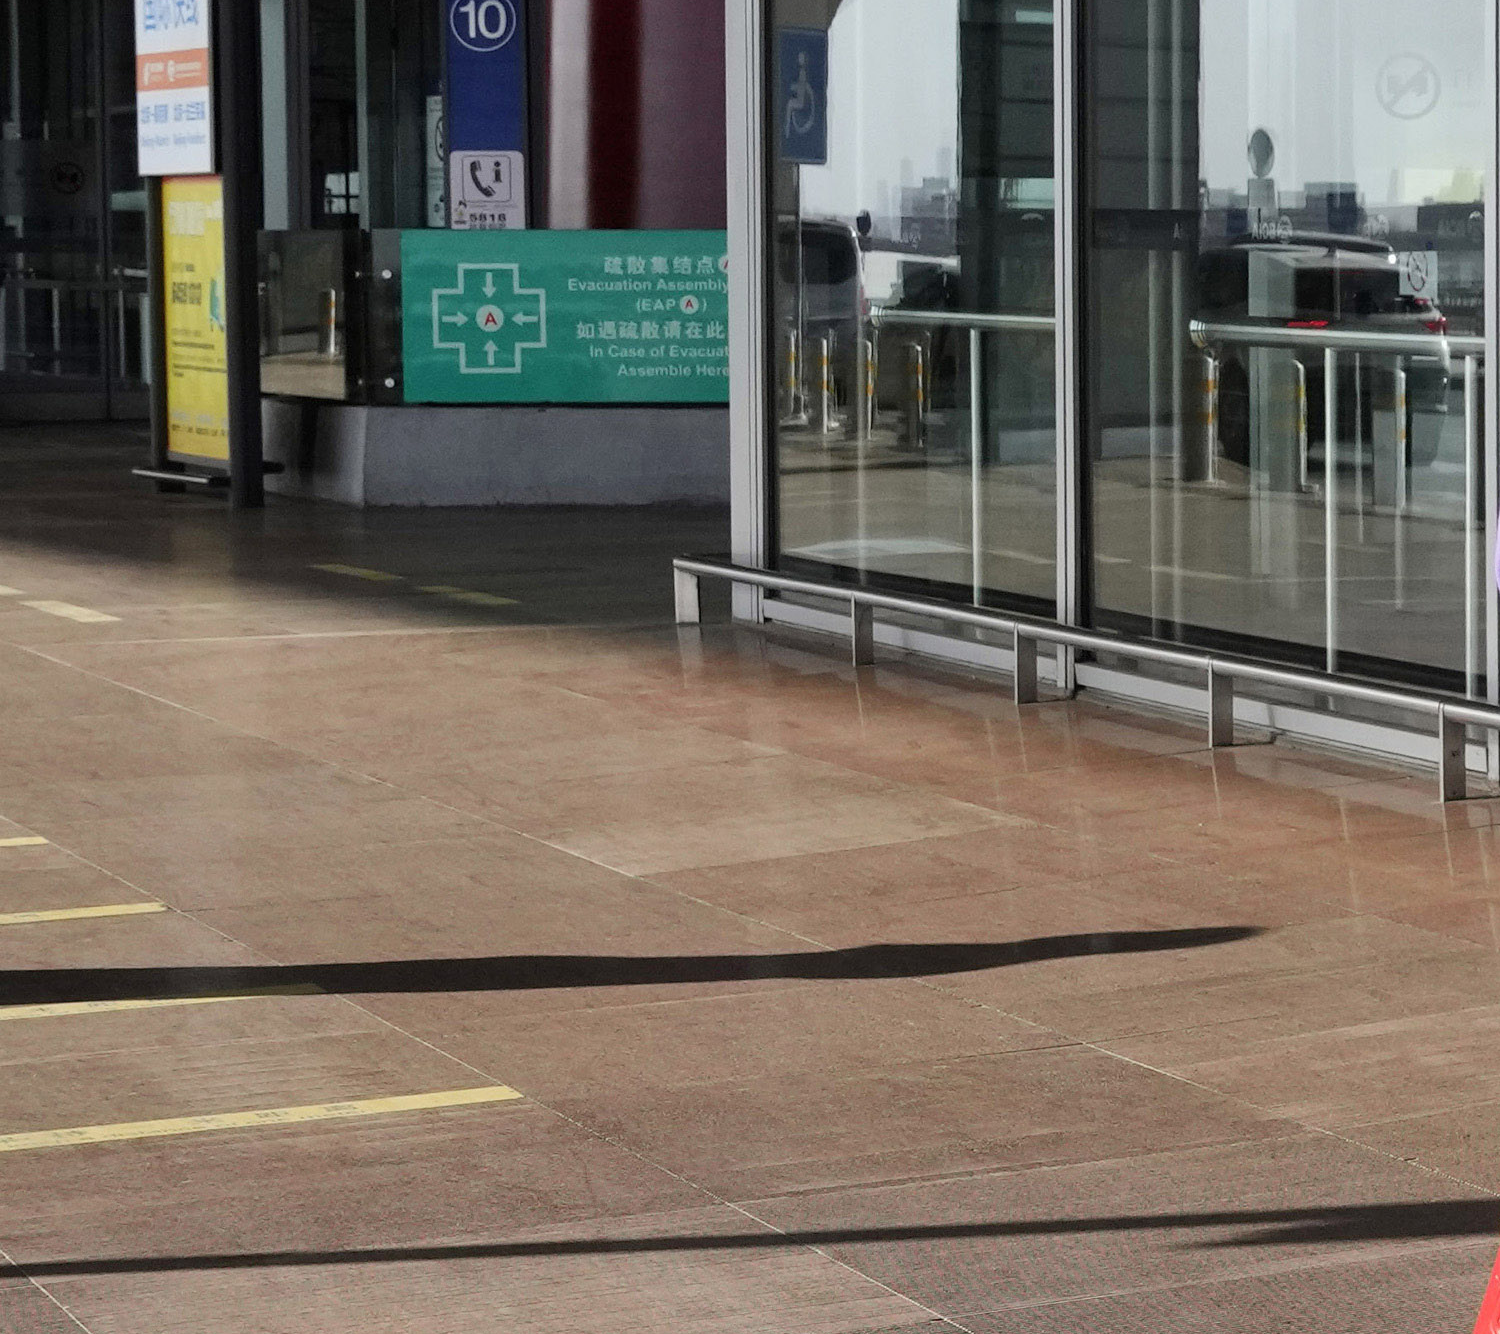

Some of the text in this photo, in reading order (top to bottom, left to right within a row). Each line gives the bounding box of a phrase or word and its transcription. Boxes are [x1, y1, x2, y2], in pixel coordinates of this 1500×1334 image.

[603, 255, 715, 275] 疏散集结点
[567, 278, 728, 294] Evacuation Assembly
[484, 311, 499, 326] A
[576, 320, 726, 340] 如遇疏散请在此
[589, 345, 604, 358] In
[608, 345, 645, 358] Case
[650, 345, 665, 358] of
[617, 364, 692, 377] Assemble
